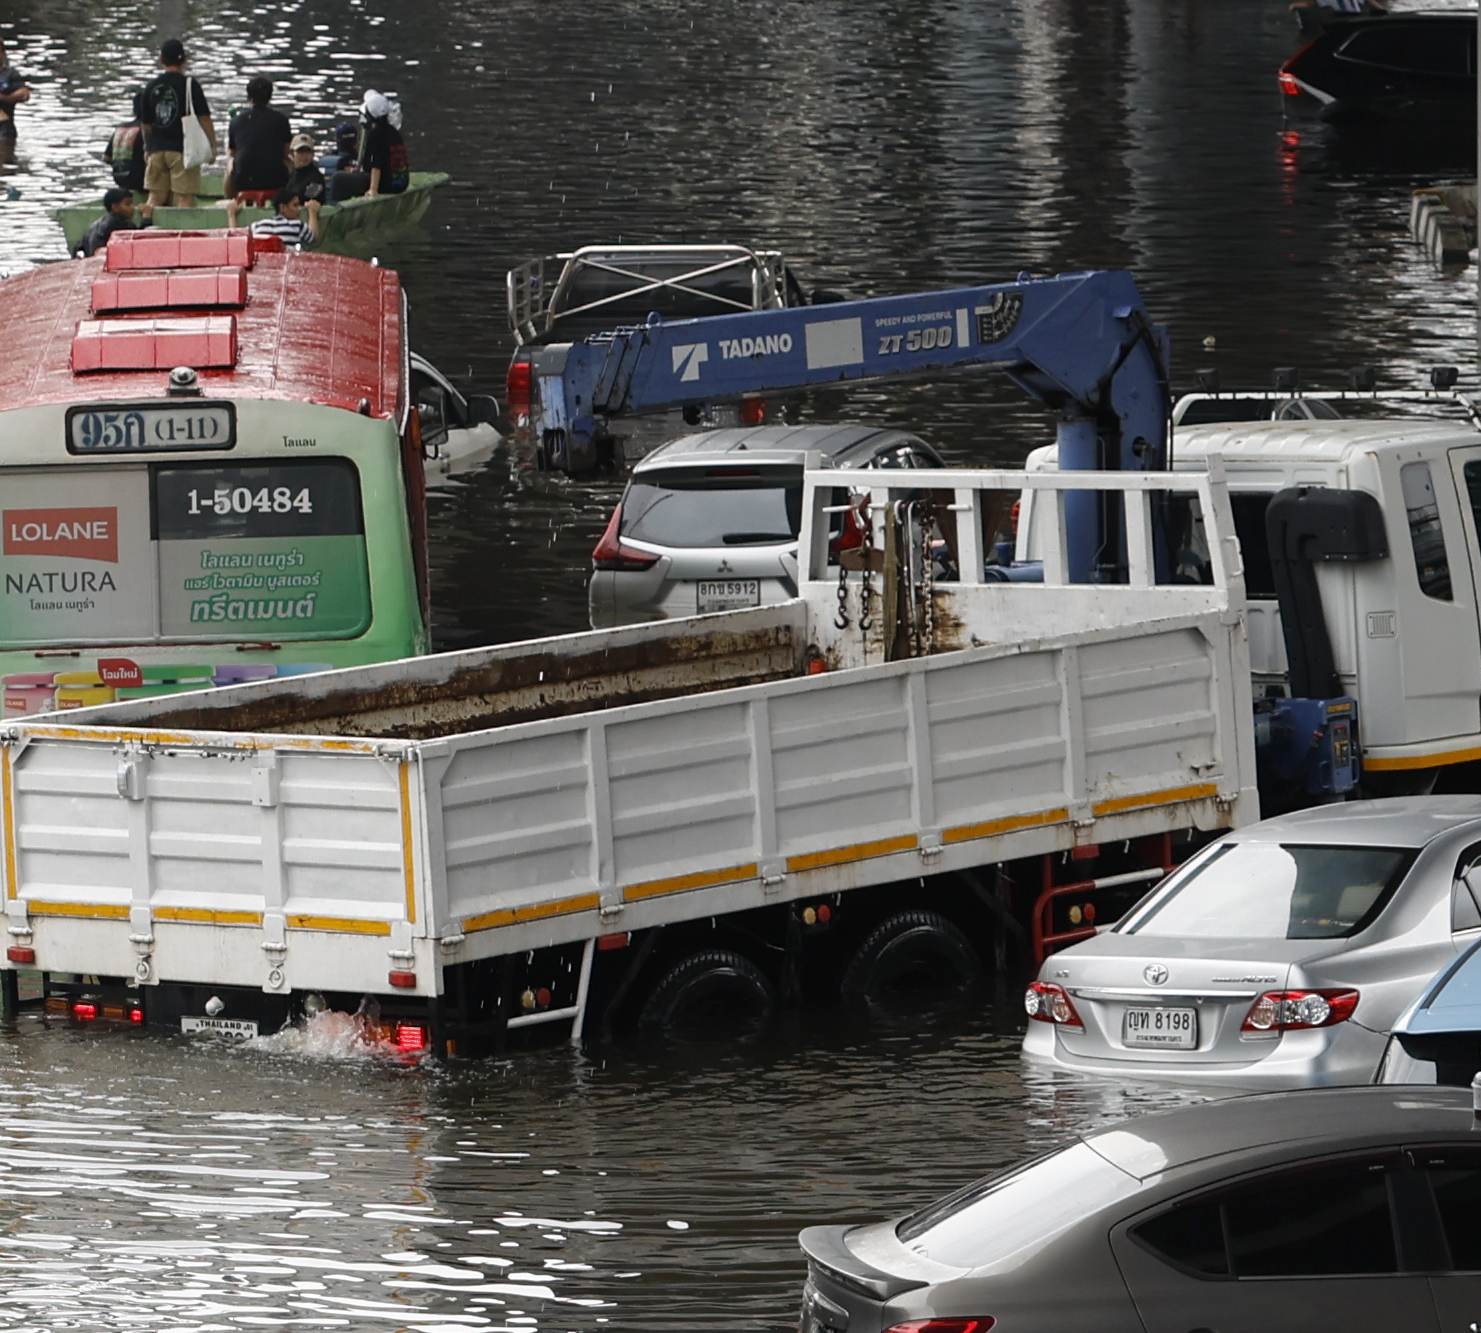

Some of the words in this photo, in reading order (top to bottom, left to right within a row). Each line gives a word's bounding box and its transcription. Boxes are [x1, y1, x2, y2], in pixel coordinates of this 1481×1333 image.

[875, 315, 901, 327] SPEEDY
[902, 314, 916, 325] AND
[917, 311, 953, 323] POWERFUL
[719, 333, 792, 359] TADANO
[878, 335, 903, 356] ZT
[906, 326, 952, 351] 500
[80, 411, 146, 448] 95ก
[155, 416, 218, 441] (1-11)
[283, 435, 316, 447] โลแลน
[188, 487, 313, 514] 1-50484
[11, 521, 109, 541] LOLANE
[201, 550, 252, 568] โลแลน
[257, 548, 304, 570] เนทูร่า
[6, 571, 117, 594] NATURA
[212, 572, 263, 589] ไวตามิน
[267, 571, 321, 591] บูสเตอร์
[727, 582, 756, 595] 5912
[30, 599, 63, 610] โลแลน
[65, 597, 95, 612] เนทูร่า
[192, 593, 316, 622] ทรีตเมนต์
[102, 668, 138, 680] โฉมใหม่
[200, 1020, 242, 1029] THAILAND
[1155, 1012, 1190, 1031] 8198
